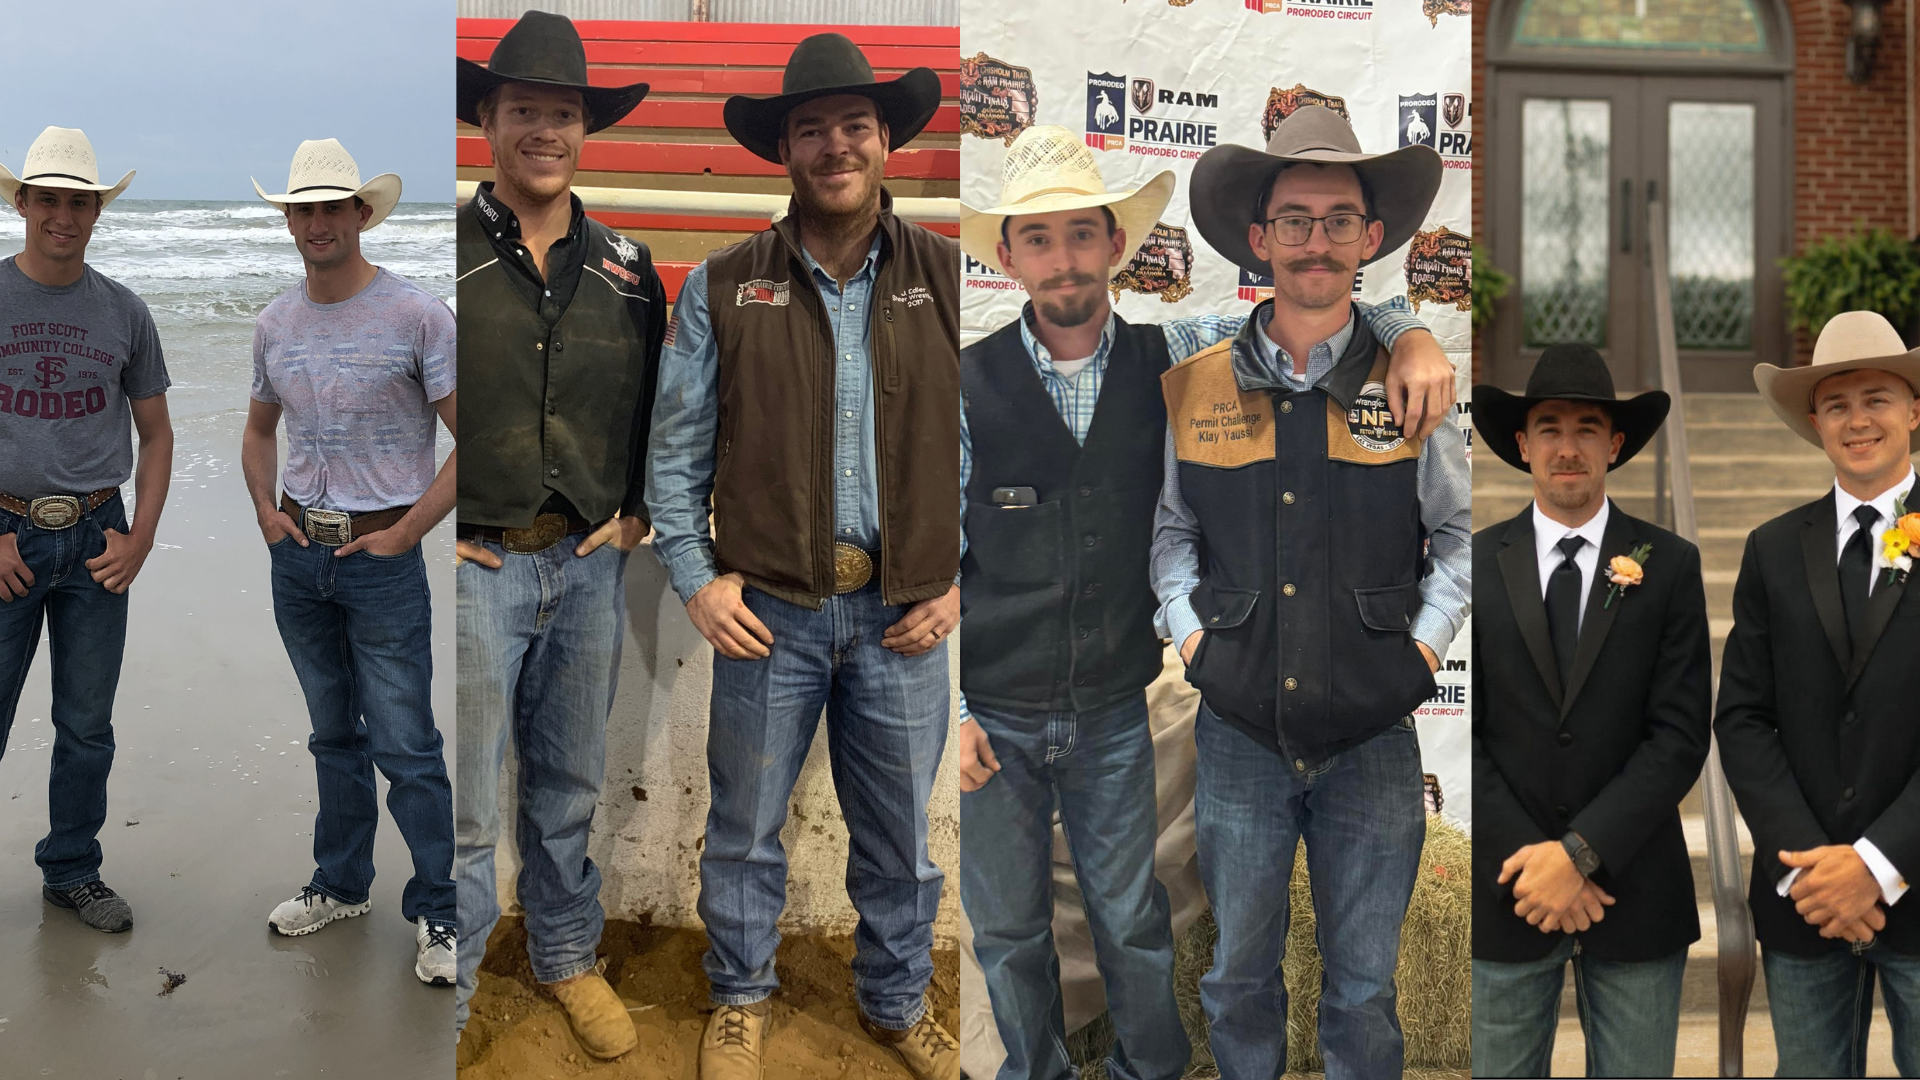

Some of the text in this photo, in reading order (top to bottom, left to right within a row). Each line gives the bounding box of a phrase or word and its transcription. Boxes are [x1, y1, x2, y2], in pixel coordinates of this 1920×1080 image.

[1287, 8, 1373, 20] PRORODEO CIRCUIT
[980, 66, 1011, 77] CHISHOLM
[1088, 78, 1126, 90] PRORODEO
[960, 93, 1010, 110] IRCUIT FINALS
[1158, 89, 1218, 108] RAM
[1400, 99, 1436, 108] PRORODEO
[1129, 118, 1218, 146] PRAIRIE
[1106, 138, 1123, 147] PRCA
[1129, 145, 1201, 160] PRORODEO CIRC
[477, 193, 500, 223] NWOSU
[602, 257, 641, 287] NWOSU
[1415, 259, 1441, 273] CIRCUIT
[965, 279, 1017, 291] PRORODEO
[1411, 272, 1436, 285] RODEO
[736, 283, 745, 306] PRCA
[907, 299, 924, 308] 2017
[11, 322, 89, 342] FORT SCOTT
[63, 342, 115, 367] COLLEGE
[7, 368, 26, 377] EST.
[78, 370, 98, 380] 1975
[0, 381, 107, 420] RODEO
[1355, 398, 1387, 410] Wrangler
[1213, 401, 1238, 415] PRCA
[1190, 412, 1262, 429] Permit Challenge
[1361, 409, 1393, 427] NF
[1198, 426, 1254, 444] Klay Yaussi
[1431, 707, 1465, 717] CIRCUIT
